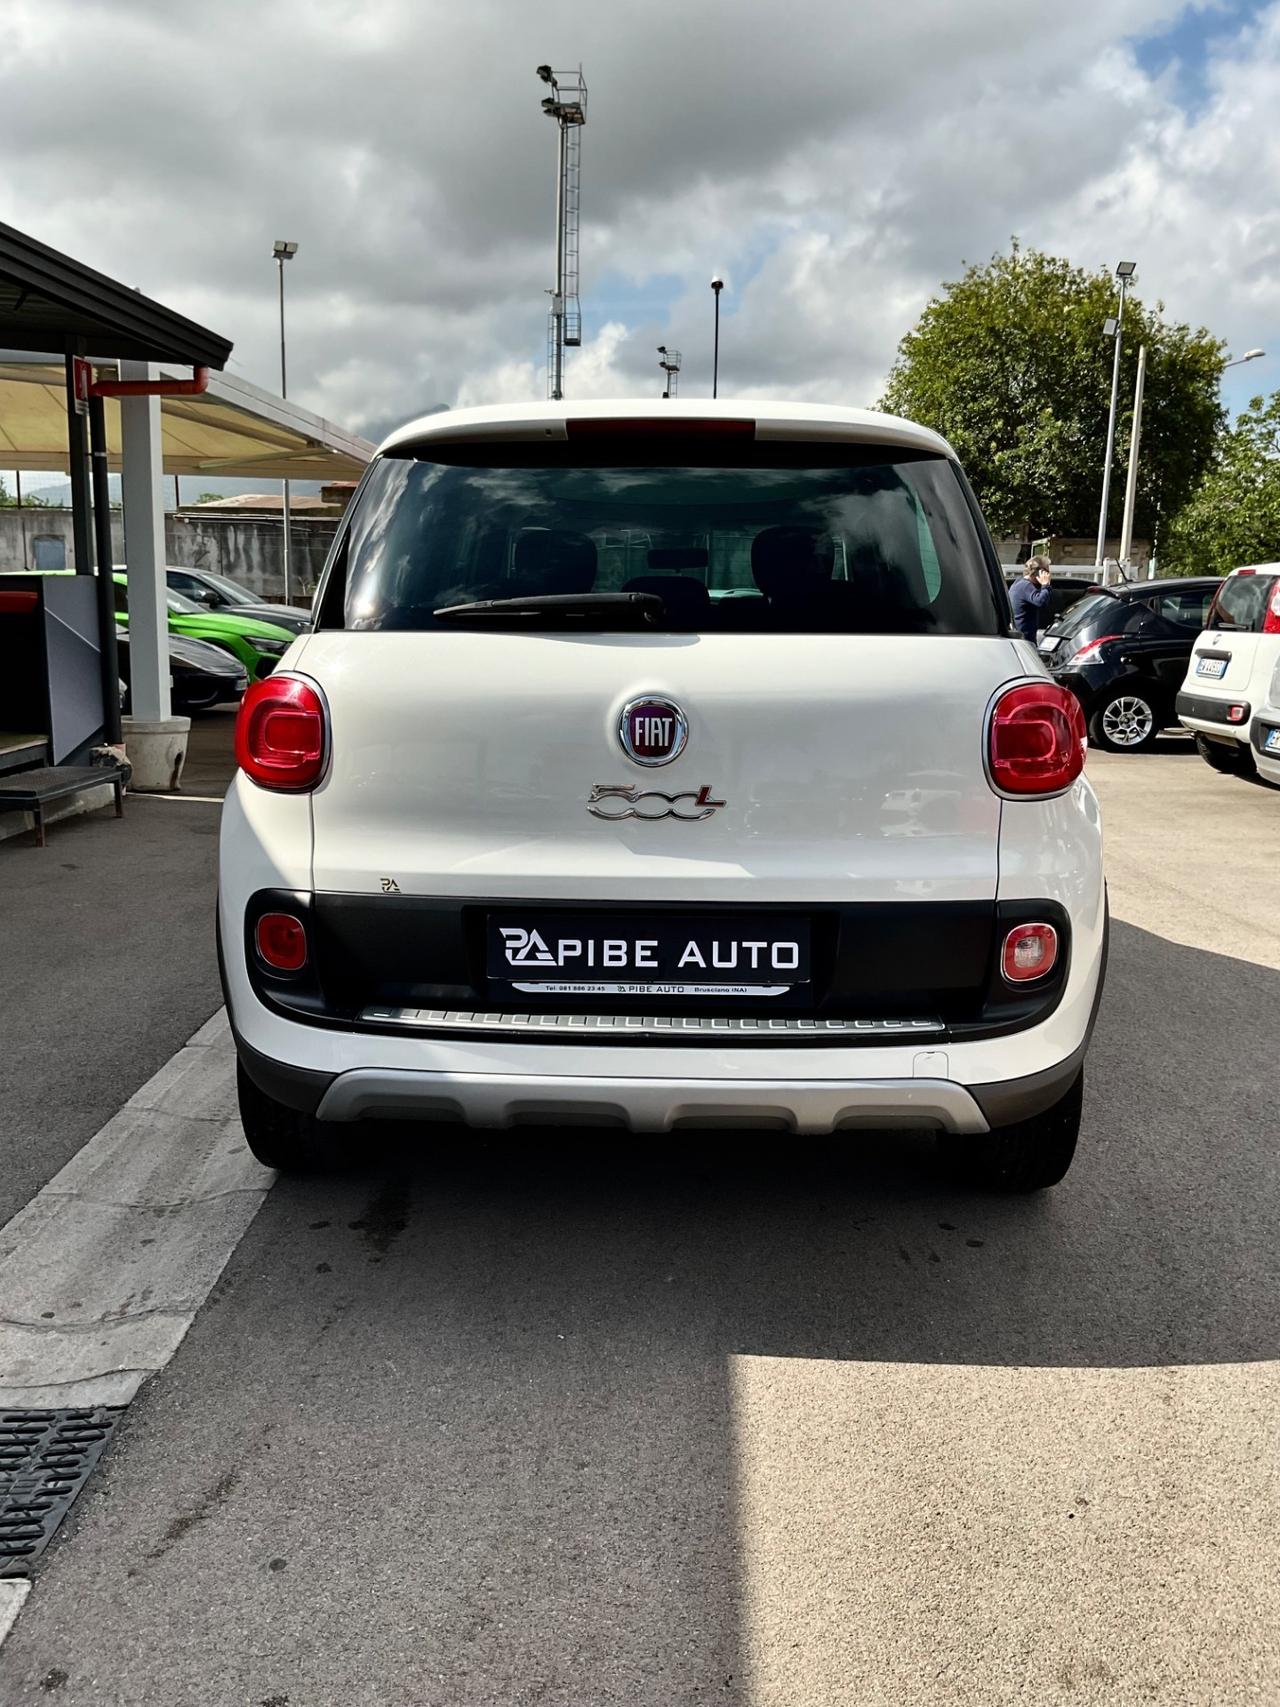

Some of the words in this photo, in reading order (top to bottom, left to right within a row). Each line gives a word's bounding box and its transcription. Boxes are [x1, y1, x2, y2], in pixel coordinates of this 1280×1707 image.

[635, 717, 673, 747] FIAT
[558, 939, 658, 967] PIBE
[677, 940, 799, 969] AUTO
